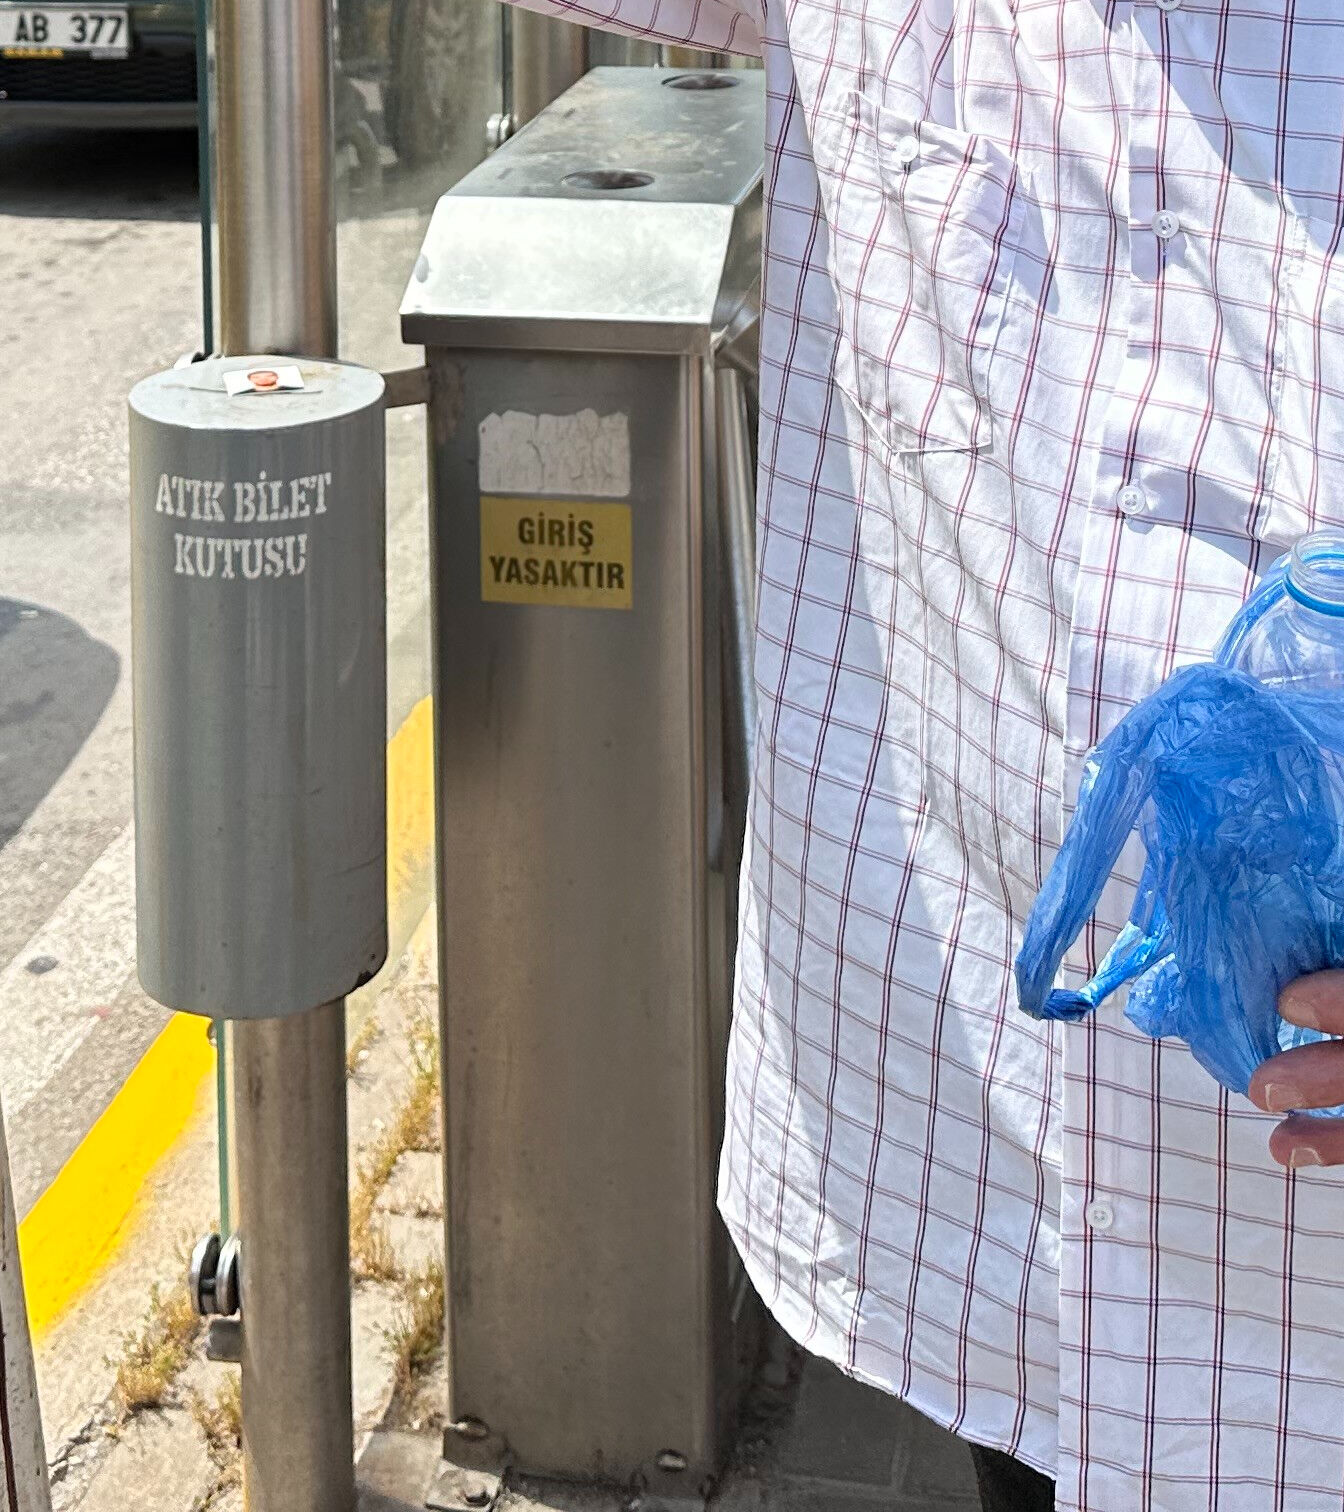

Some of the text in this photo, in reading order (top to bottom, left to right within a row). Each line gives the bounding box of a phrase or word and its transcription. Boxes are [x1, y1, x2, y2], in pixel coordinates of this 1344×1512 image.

[15, 13, 49, 43] AB
[69, 14, 123, 44] 377
[155, 470, 332, 525] ATIK BİLET
[173, 533, 309, 579] KUTUSU
[517, 511, 595, 556] GİRİŞ
[489, 554, 625, 591] YASAKTIR
